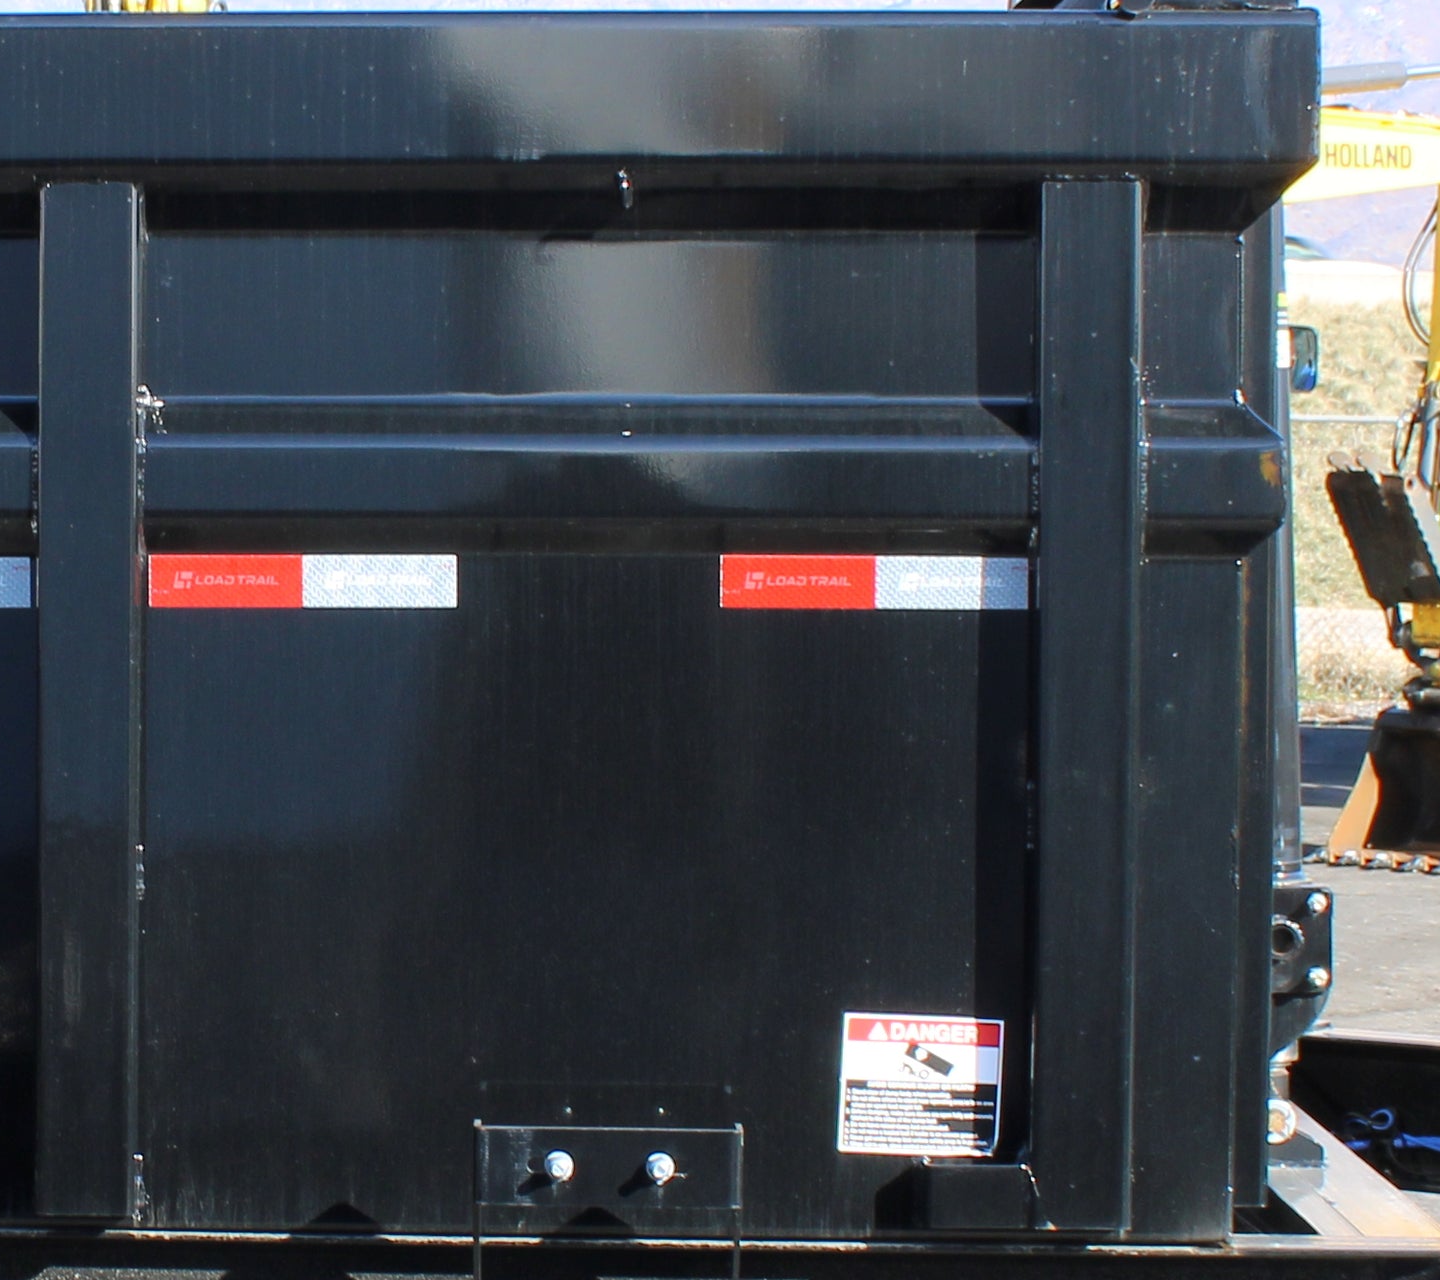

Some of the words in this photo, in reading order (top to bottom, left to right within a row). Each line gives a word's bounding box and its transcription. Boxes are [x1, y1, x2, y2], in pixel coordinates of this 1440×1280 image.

[1324, 143, 1413, 169] HOLLAND
[194, 574, 235, 585] LOAD
[236, 574, 279, 586] TRAIL
[766, 575, 807, 586] LOAD
[808, 576, 852, 587] TRAIL
[890, 1022, 979, 1044] DANGER
